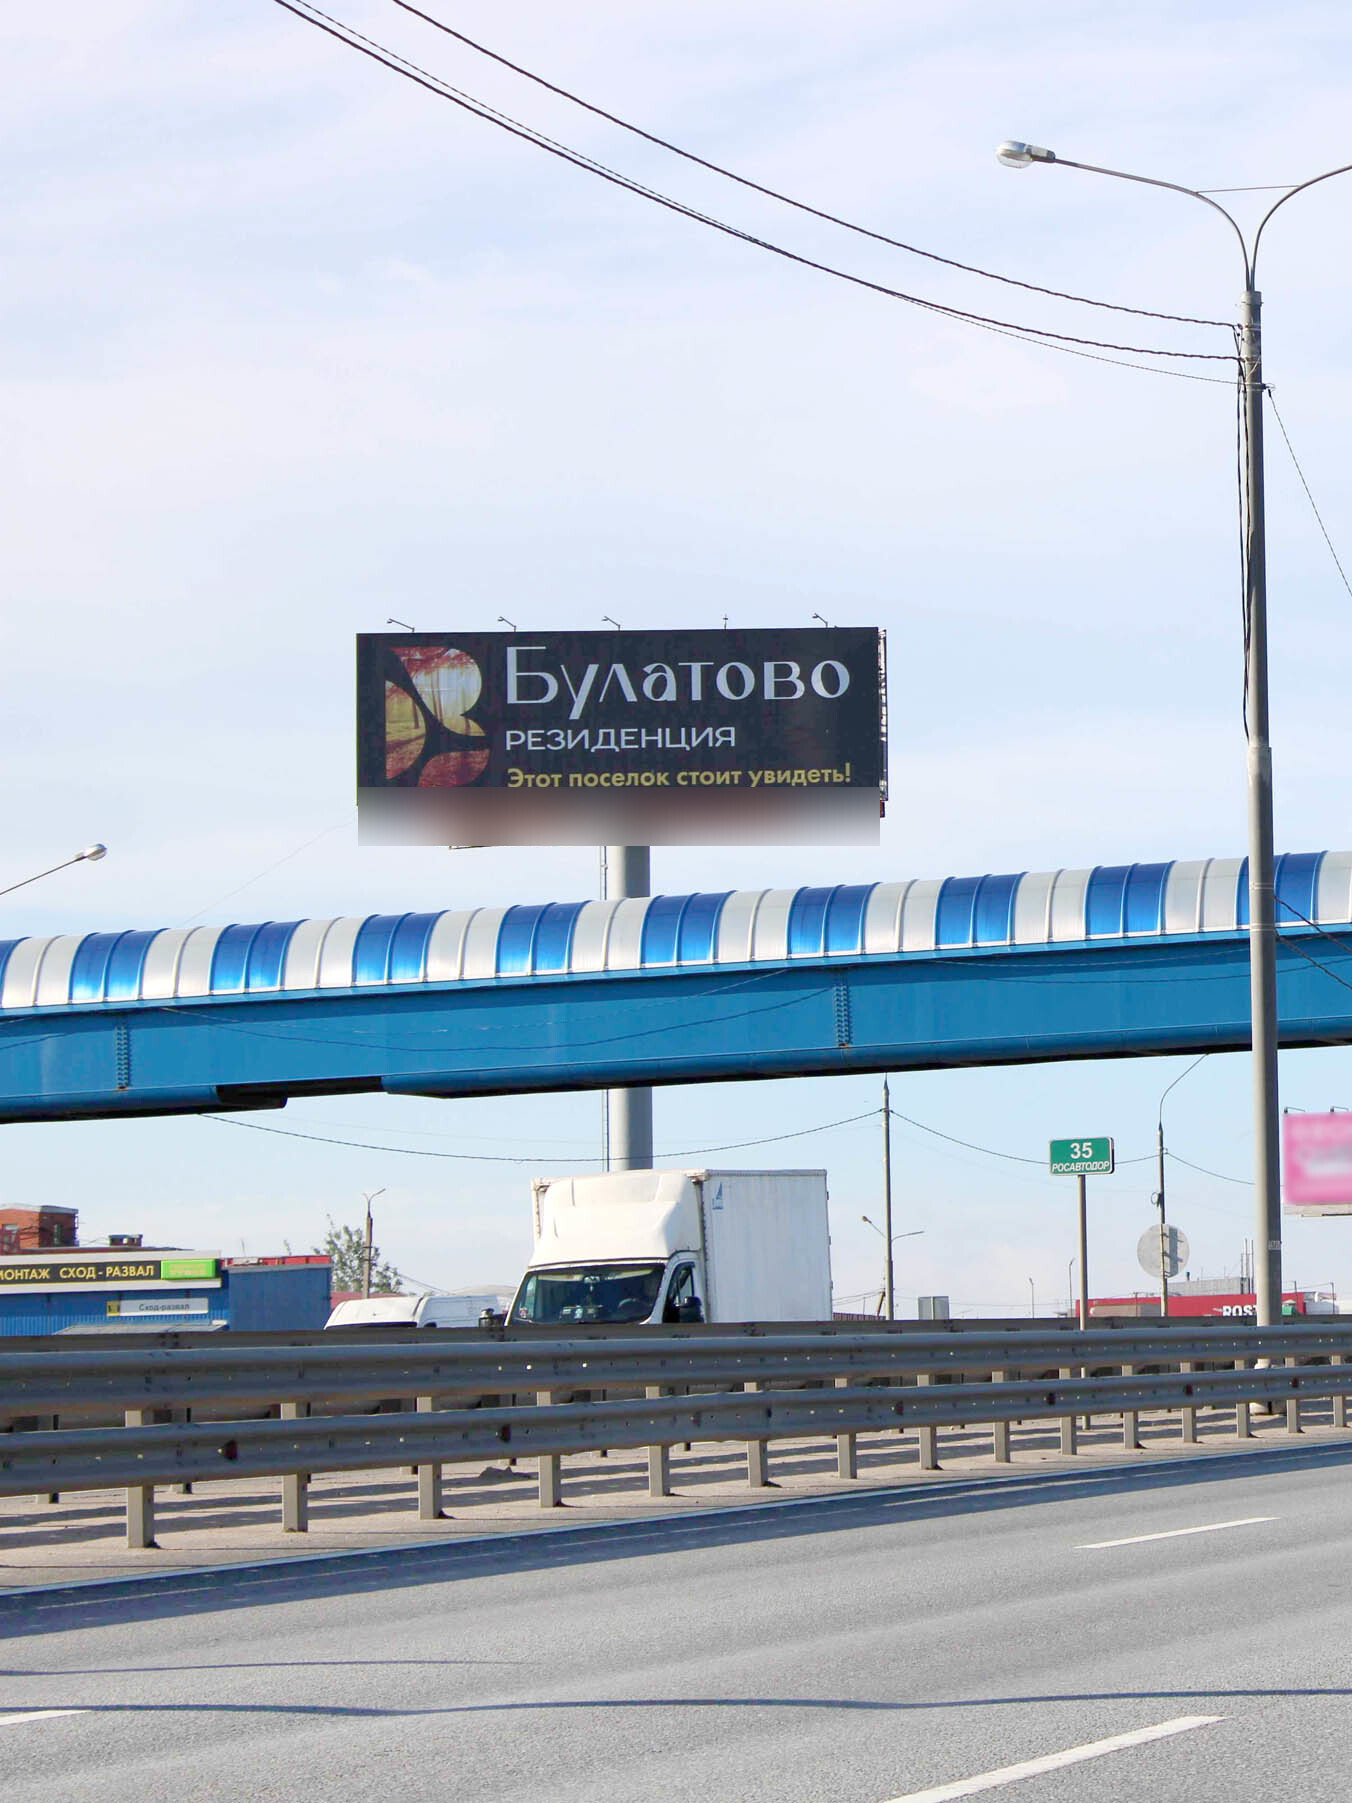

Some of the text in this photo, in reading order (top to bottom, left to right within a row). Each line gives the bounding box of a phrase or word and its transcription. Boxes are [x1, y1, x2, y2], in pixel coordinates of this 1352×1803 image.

[506, 646, 850, 720] Булатово
[505, 727, 736, 752] РЕЗИДЕНЦИЯ
[507, 762, 851, 788] Этот поселок стоит увидеть!
[1070, 1142, 1093, 1159] 35
[1052, 1161, 1110, 1172] РОСАВТОДОР
[59, 1266, 96, 1280] СХОД
[105, 1264, 155, 1277] РАЗВАЛ
